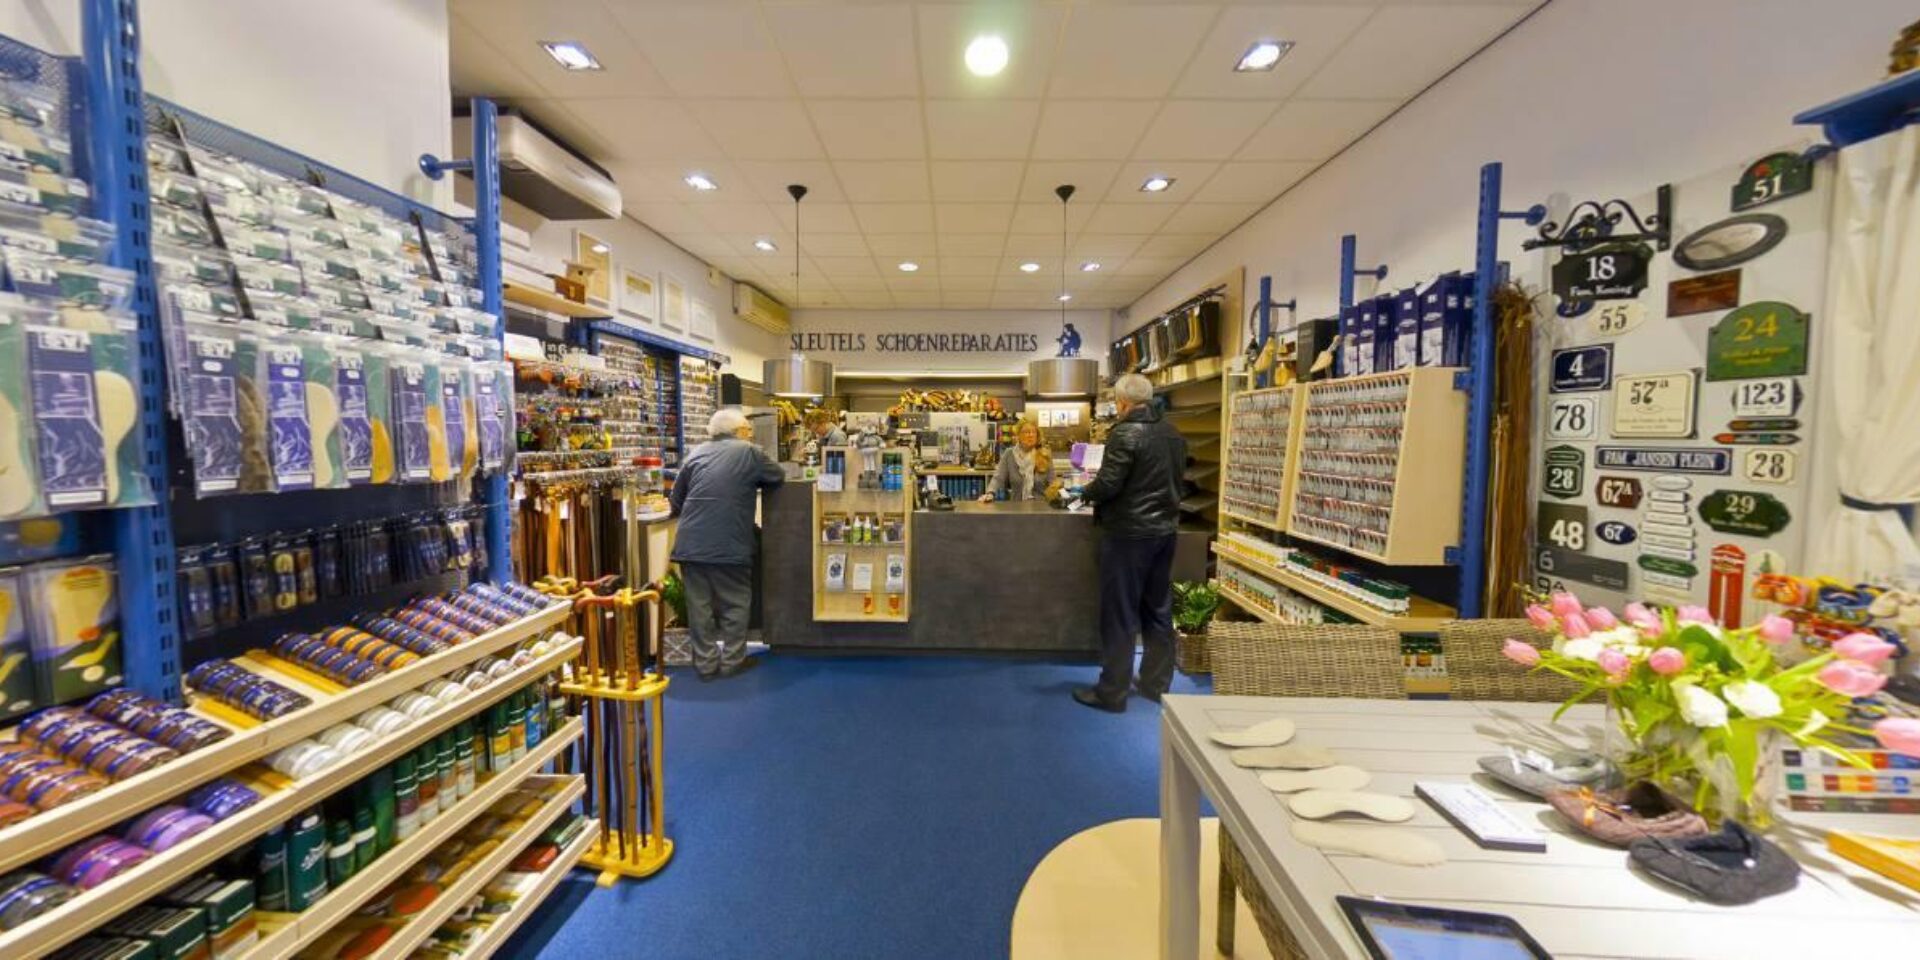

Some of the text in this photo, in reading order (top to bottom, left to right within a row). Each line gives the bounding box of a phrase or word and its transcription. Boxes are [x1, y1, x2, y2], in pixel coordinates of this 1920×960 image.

[1752, 173, 1783, 202] 51
[1586, 255, 1616, 281] 18
[1599, 305, 1629, 332] 55
[1734, 312, 1780, 342] 24
[790, 333, 1038, 353] SLEUTELS SCHOENREPARATIES
[1569, 353, 1585, 377] 4
[1742, 380, 1786, 406] 123
[1554, 403, 1586, 432] 78
[1632, 451, 1677, 467] JANSEN
[1679, 452, 1715, 469] PLEIN
[1751, 453, 1785, 480] 28
[1550, 467, 1574, 490] 28
[1601, 479, 1633, 504] 67A
[1725, 493, 1756, 515] 29
[1549, 519, 1584, 551] 48
[1604, 524, 1625, 542] 67
[1539, 550, 1554, 572] 6
